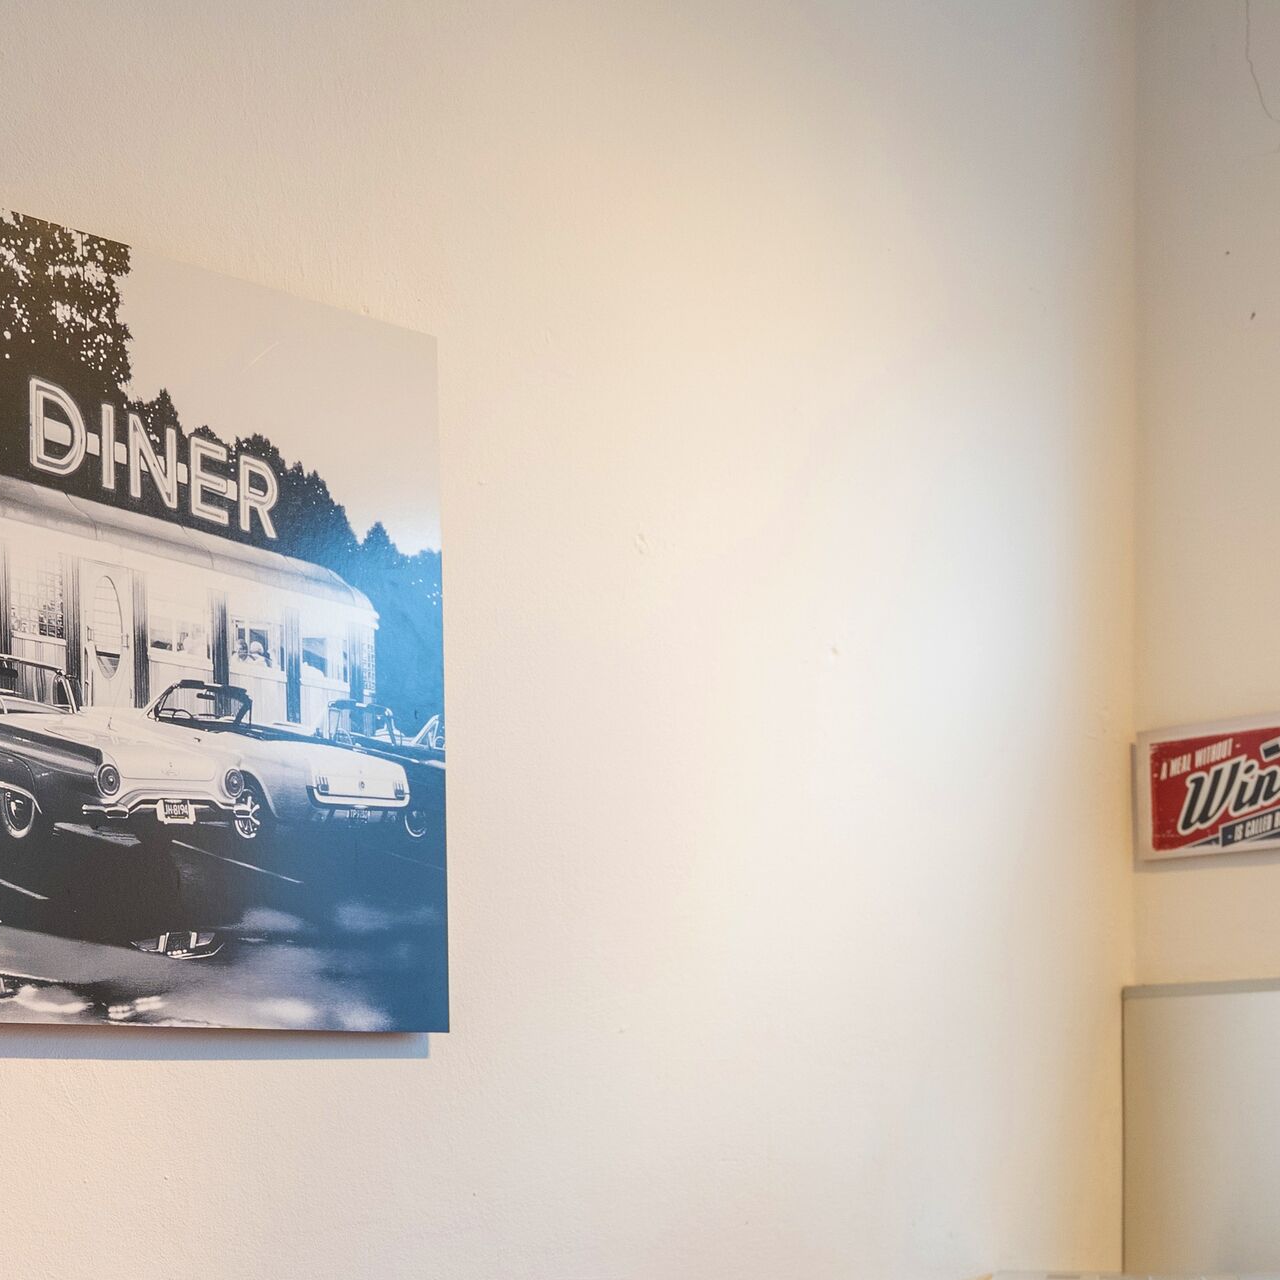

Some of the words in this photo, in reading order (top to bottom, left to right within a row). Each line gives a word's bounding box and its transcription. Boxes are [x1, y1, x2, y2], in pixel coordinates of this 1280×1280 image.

[28, 376, 280, 540] DINER
[1160, 761, 1168, 780] A
[1169, 753, 1191, 778] MEAL
[1195, 737, 1234, 769] WITHOUT
[1233, 823, 1244, 842] IS
[1244, 813, 1274, 838] CALLED
